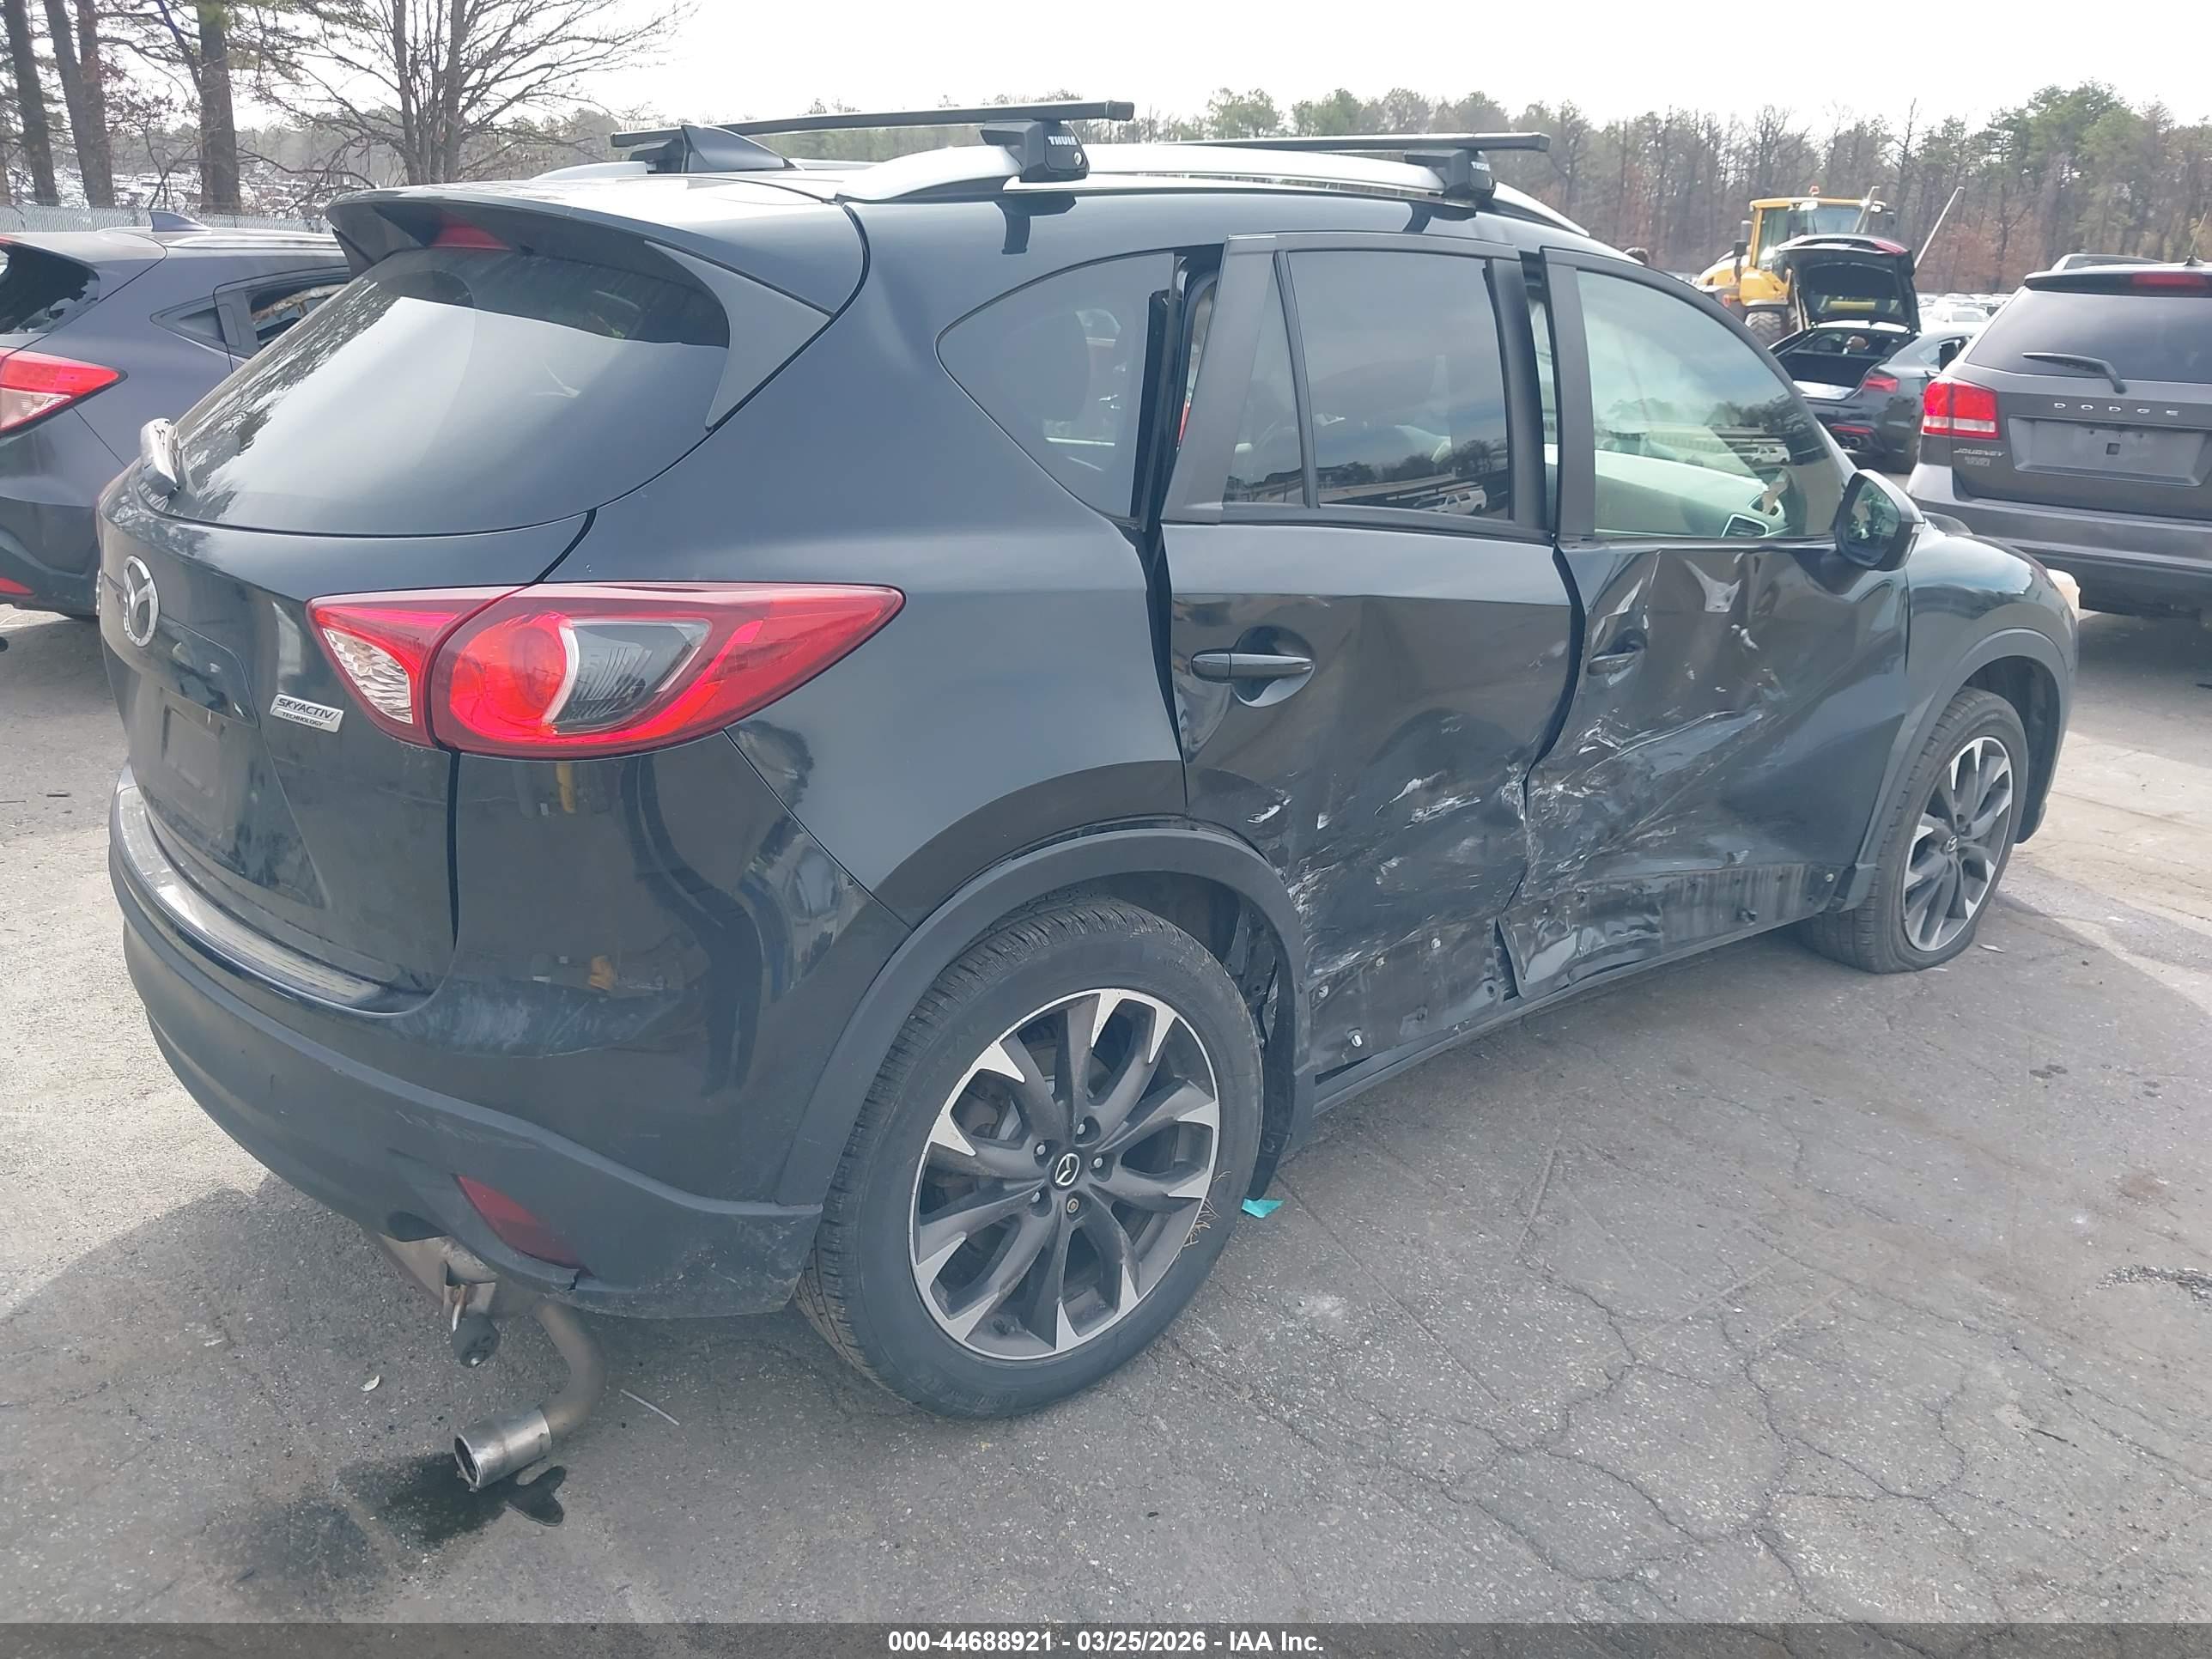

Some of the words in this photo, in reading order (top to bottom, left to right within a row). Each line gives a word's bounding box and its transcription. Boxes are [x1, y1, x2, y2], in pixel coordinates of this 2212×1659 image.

[1048, 136, 1078, 146] THULE
[2053, 402, 2180, 416] DODGE
[276, 697, 334, 719] SKYACTIV
[281, 711, 324, 727] TECHNOLOGY
